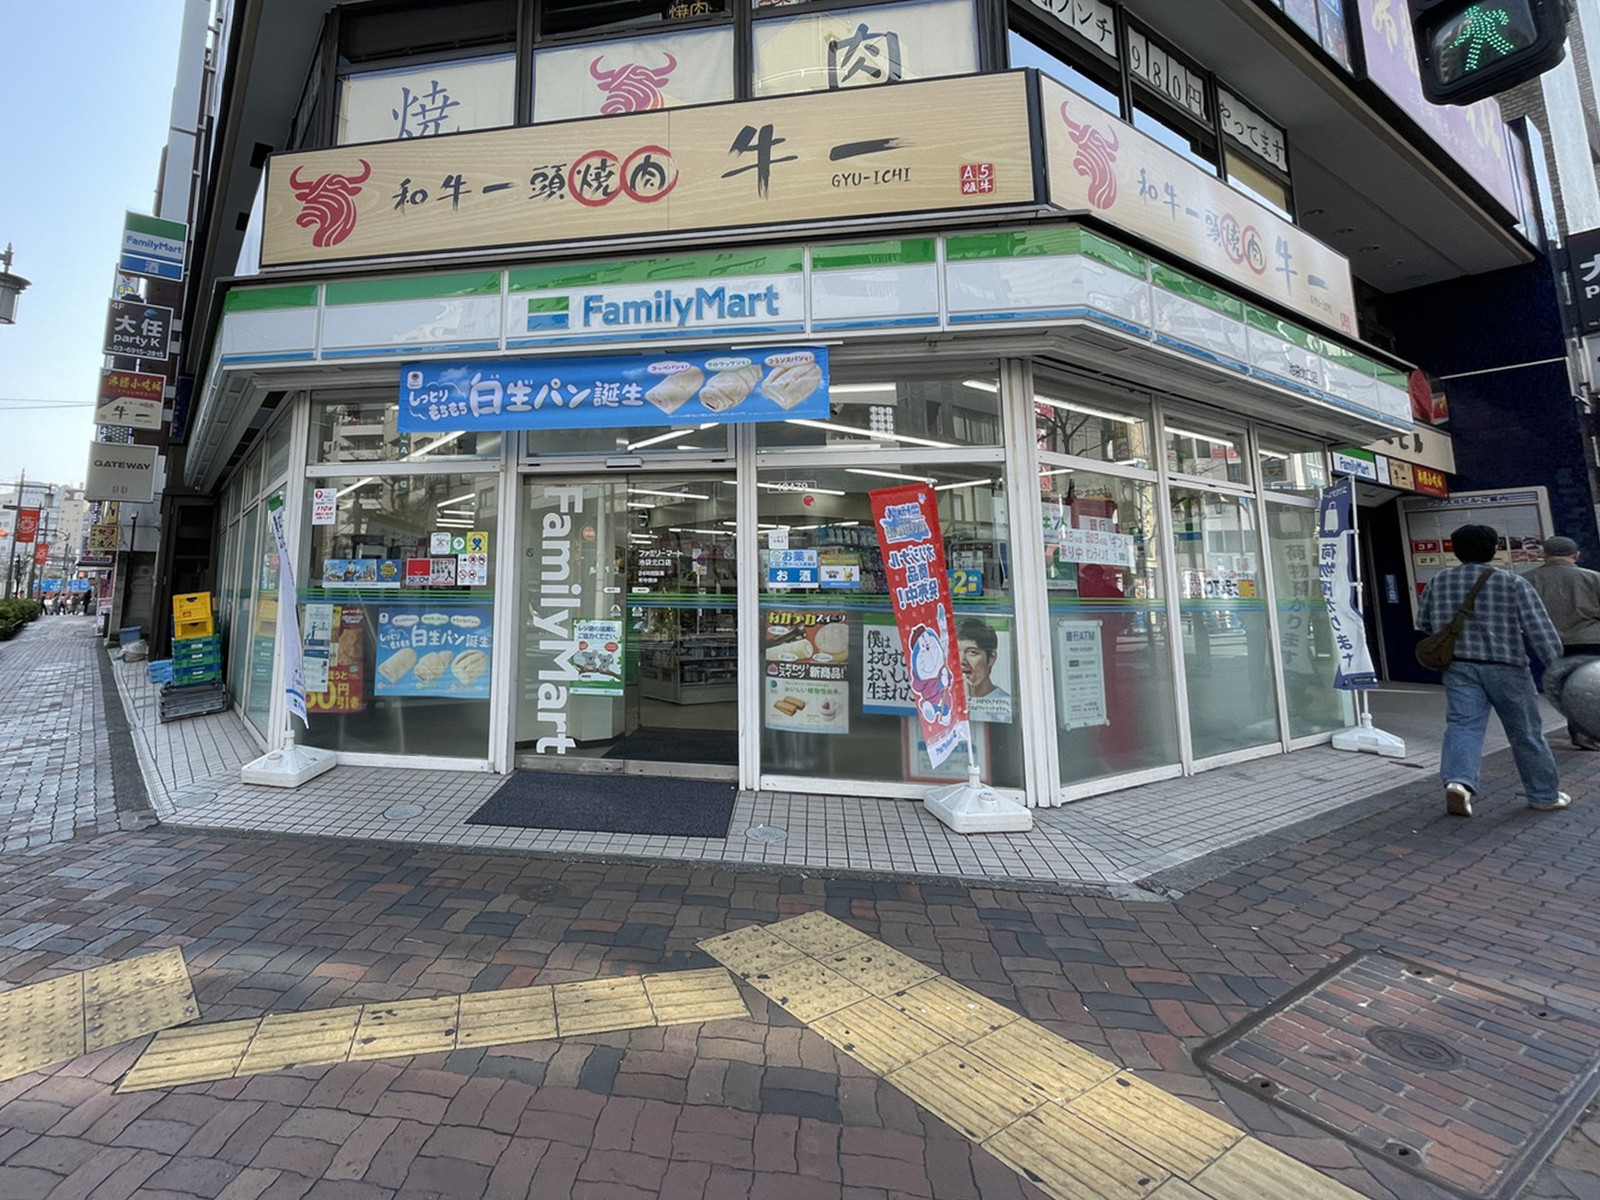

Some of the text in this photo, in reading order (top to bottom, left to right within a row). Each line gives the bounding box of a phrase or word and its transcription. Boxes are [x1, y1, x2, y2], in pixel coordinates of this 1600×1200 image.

[828, 23, 902, 90] 肉
[1131, 45, 1203, 113] 980円
[1219, 100, 1286, 162] やってます
[391, 123, 915, 215] 和牛一頭焼肉 牛一
[831, 167, 911, 188] GYU-ICHI
[1137, 167, 1329, 297] 和牛一頭焼肉 牛一
[126, 235, 182, 254] FamilyMart
[111, 301, 125, 310] 4F
[583, 284, 780, 327] FamilyMart
[114, 315, 163, 337] 大任
[113, 334, 161, 348] party K
[409, 390, 449, 406] しっとり
[470, 372, 644, 418] 白生パン誕生
[111, 405, 150, 420] 牛一
[428, 401, 467, 421] もちもち
[94, 460, 151, 470] GATEWAY
[533, 486, 583, 755] FamilyMart
